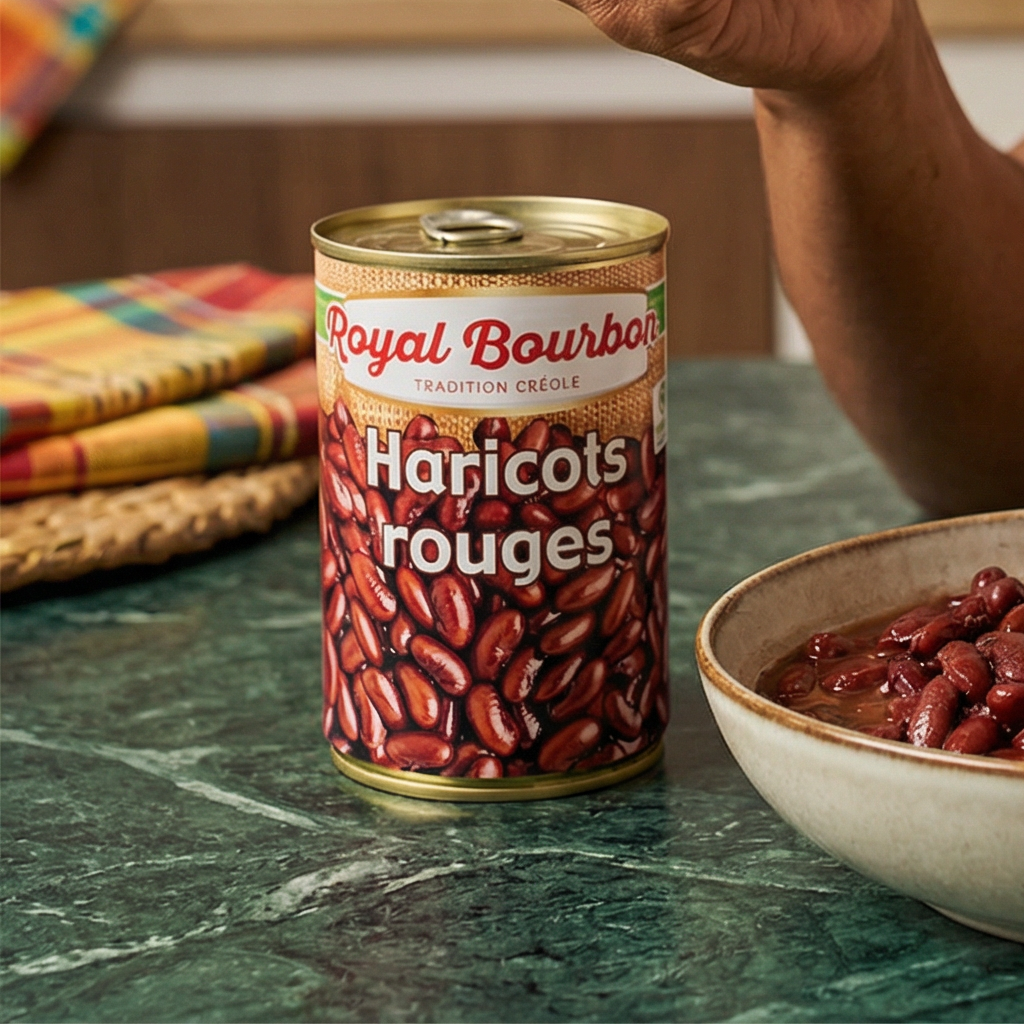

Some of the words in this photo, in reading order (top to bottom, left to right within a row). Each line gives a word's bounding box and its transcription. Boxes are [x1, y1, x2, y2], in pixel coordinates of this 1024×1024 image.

[327, 304, 452, 377] Royal
[463, 310, 660, 371] Bourbon
[414, 378, 508, 394] TRADITION
[516, 374, 580, 393] CRÉOLE
[365, 427, 627, 497] Haricots
[381, 518, 613, 585] rouges
